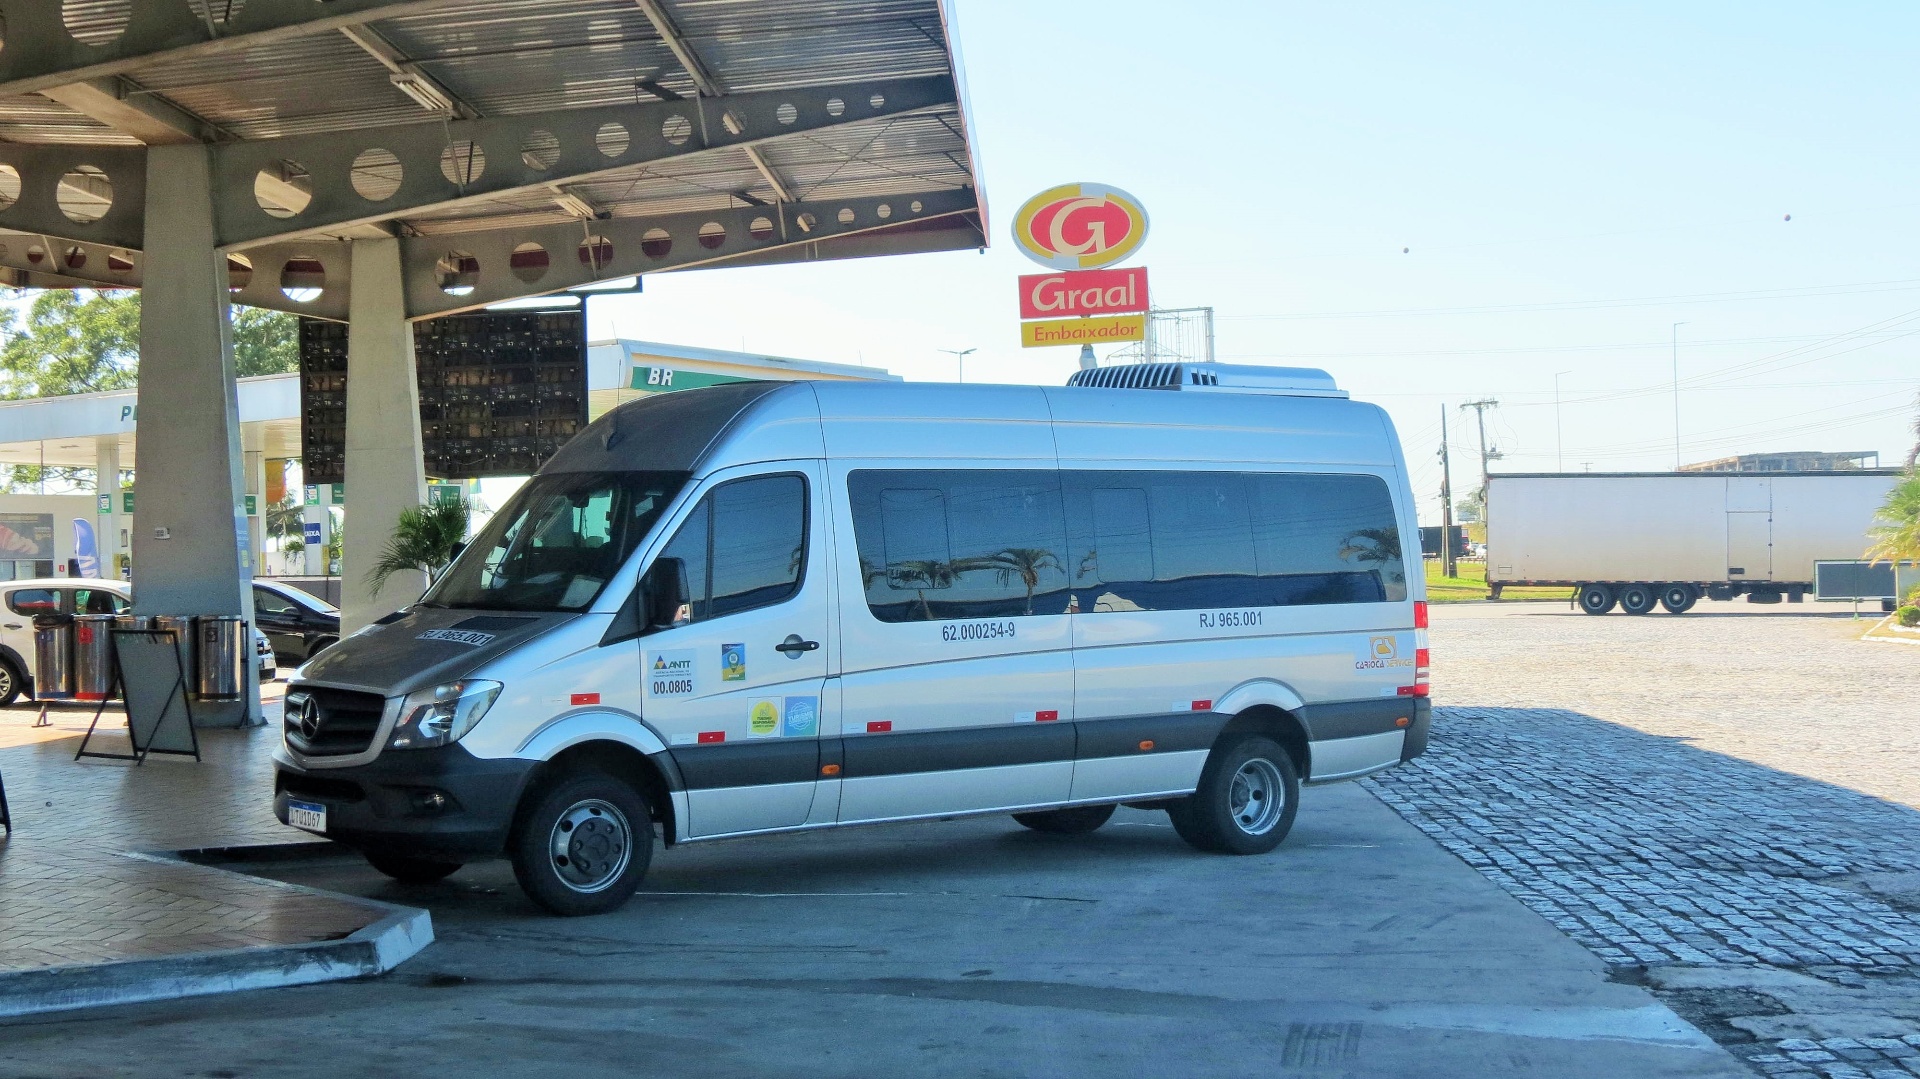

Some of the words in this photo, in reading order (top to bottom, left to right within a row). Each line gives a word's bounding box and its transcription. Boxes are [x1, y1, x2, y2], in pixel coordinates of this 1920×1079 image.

[1031, 273, 1136, 312] Graal
[1034, 322, 1138, 342] Embaixador
[647, 367, 673, 386] BR
[1199, 613, 1215, 628] RJ
[1218, 611, 1262, 627] 965.001
[438, 630, 492, 645] 965.001
[942, 622, 1015, 641] 62.000254-9
[668, 660, 691, 669] ANTT
[653, 680, 692, 695] 00.0805
